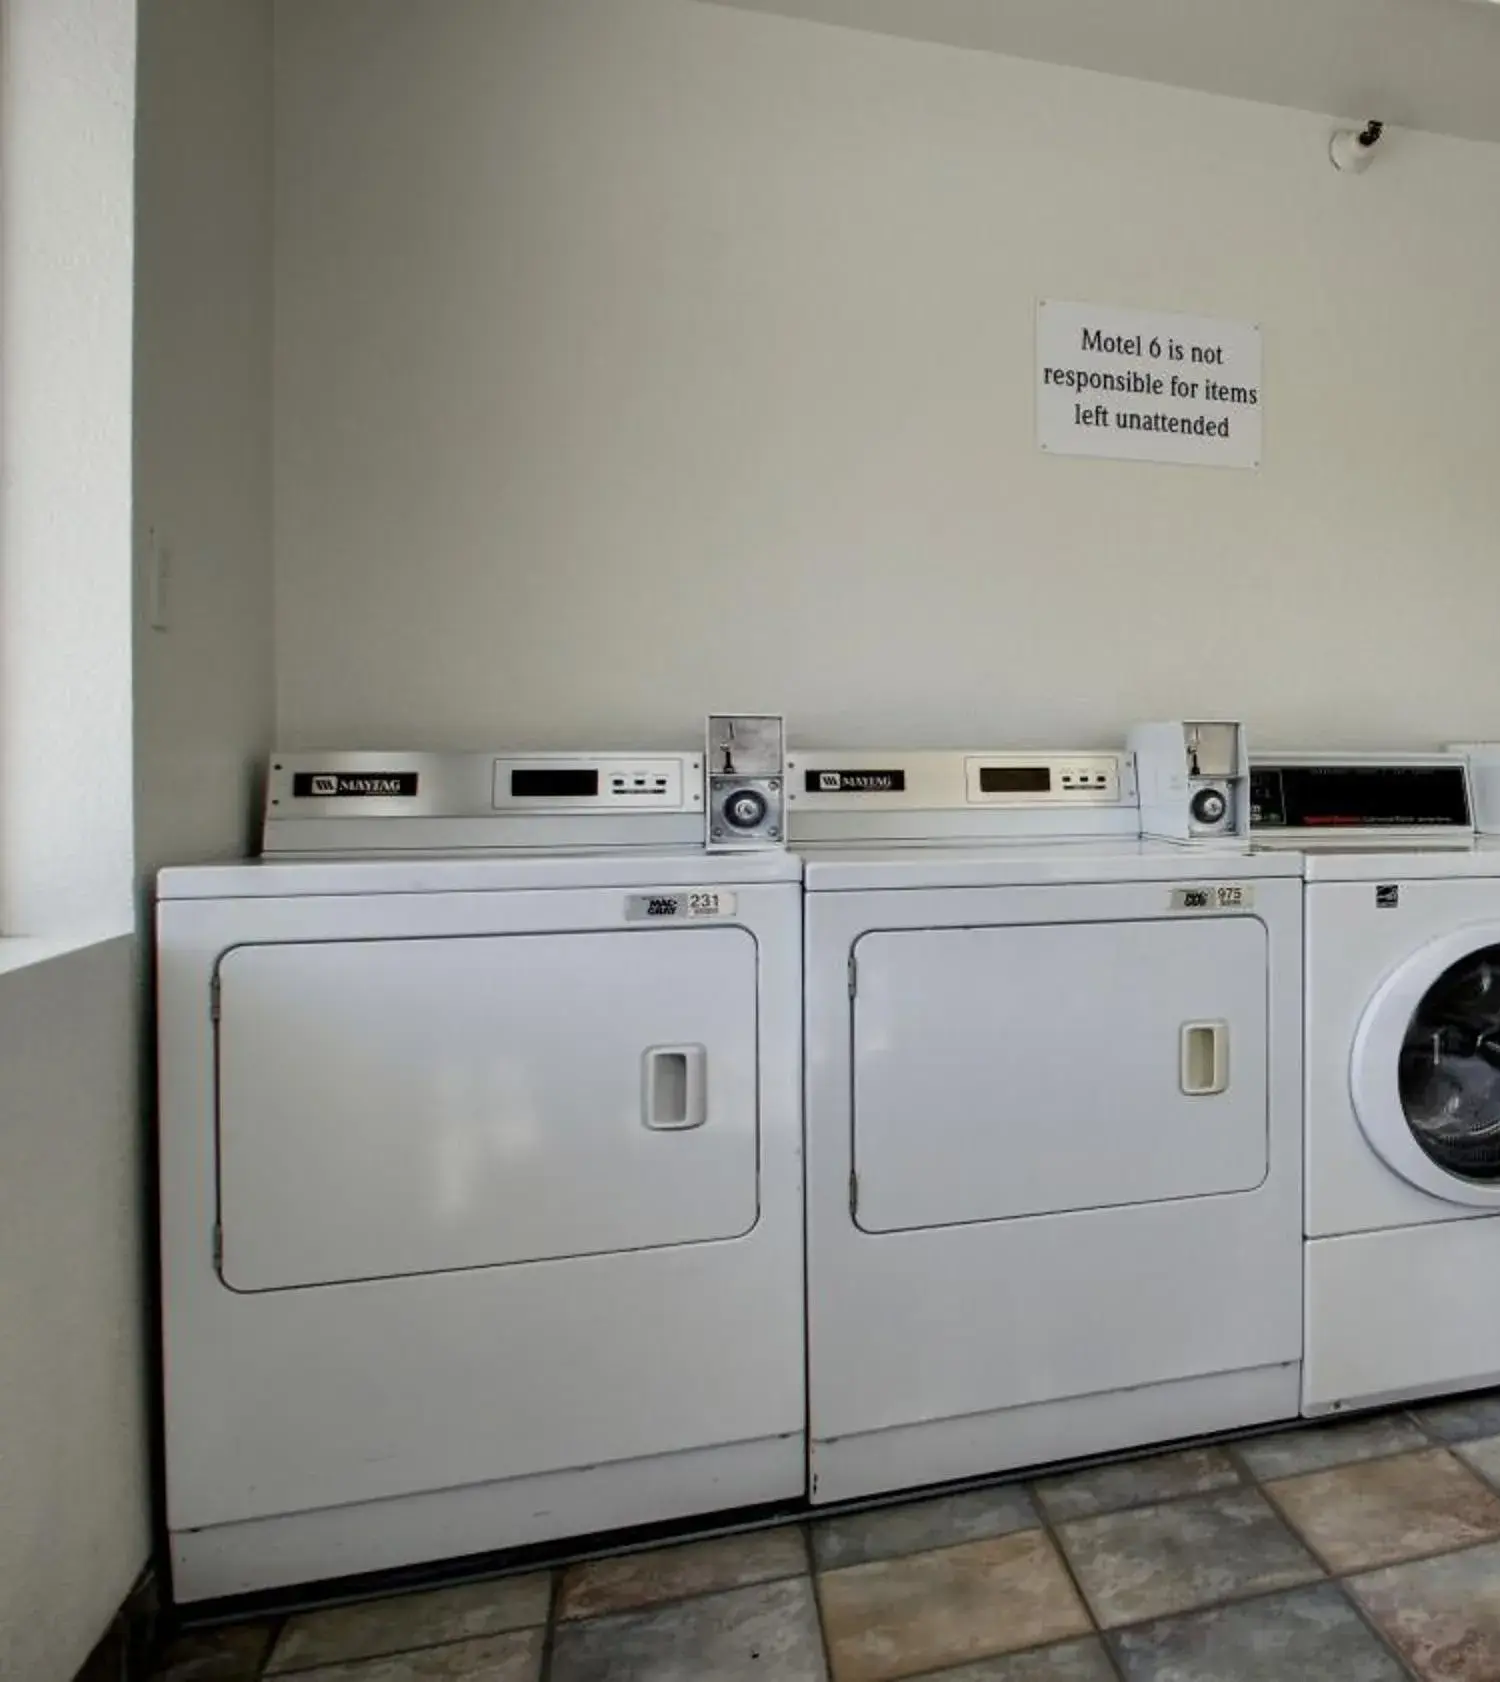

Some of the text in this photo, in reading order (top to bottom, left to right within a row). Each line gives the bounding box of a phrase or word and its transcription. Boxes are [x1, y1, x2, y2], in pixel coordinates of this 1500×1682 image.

[1081, 327, 1223, 365] Motel 6 is not
[1043, 366, 1258, 405] responsible for items
[1074, 403, 1229, 438] left unattended
[339, 779, 401, 791] MAYTAG
[690, 893, 719, 908] 231
[1217, 887, 1242, 899] 975
